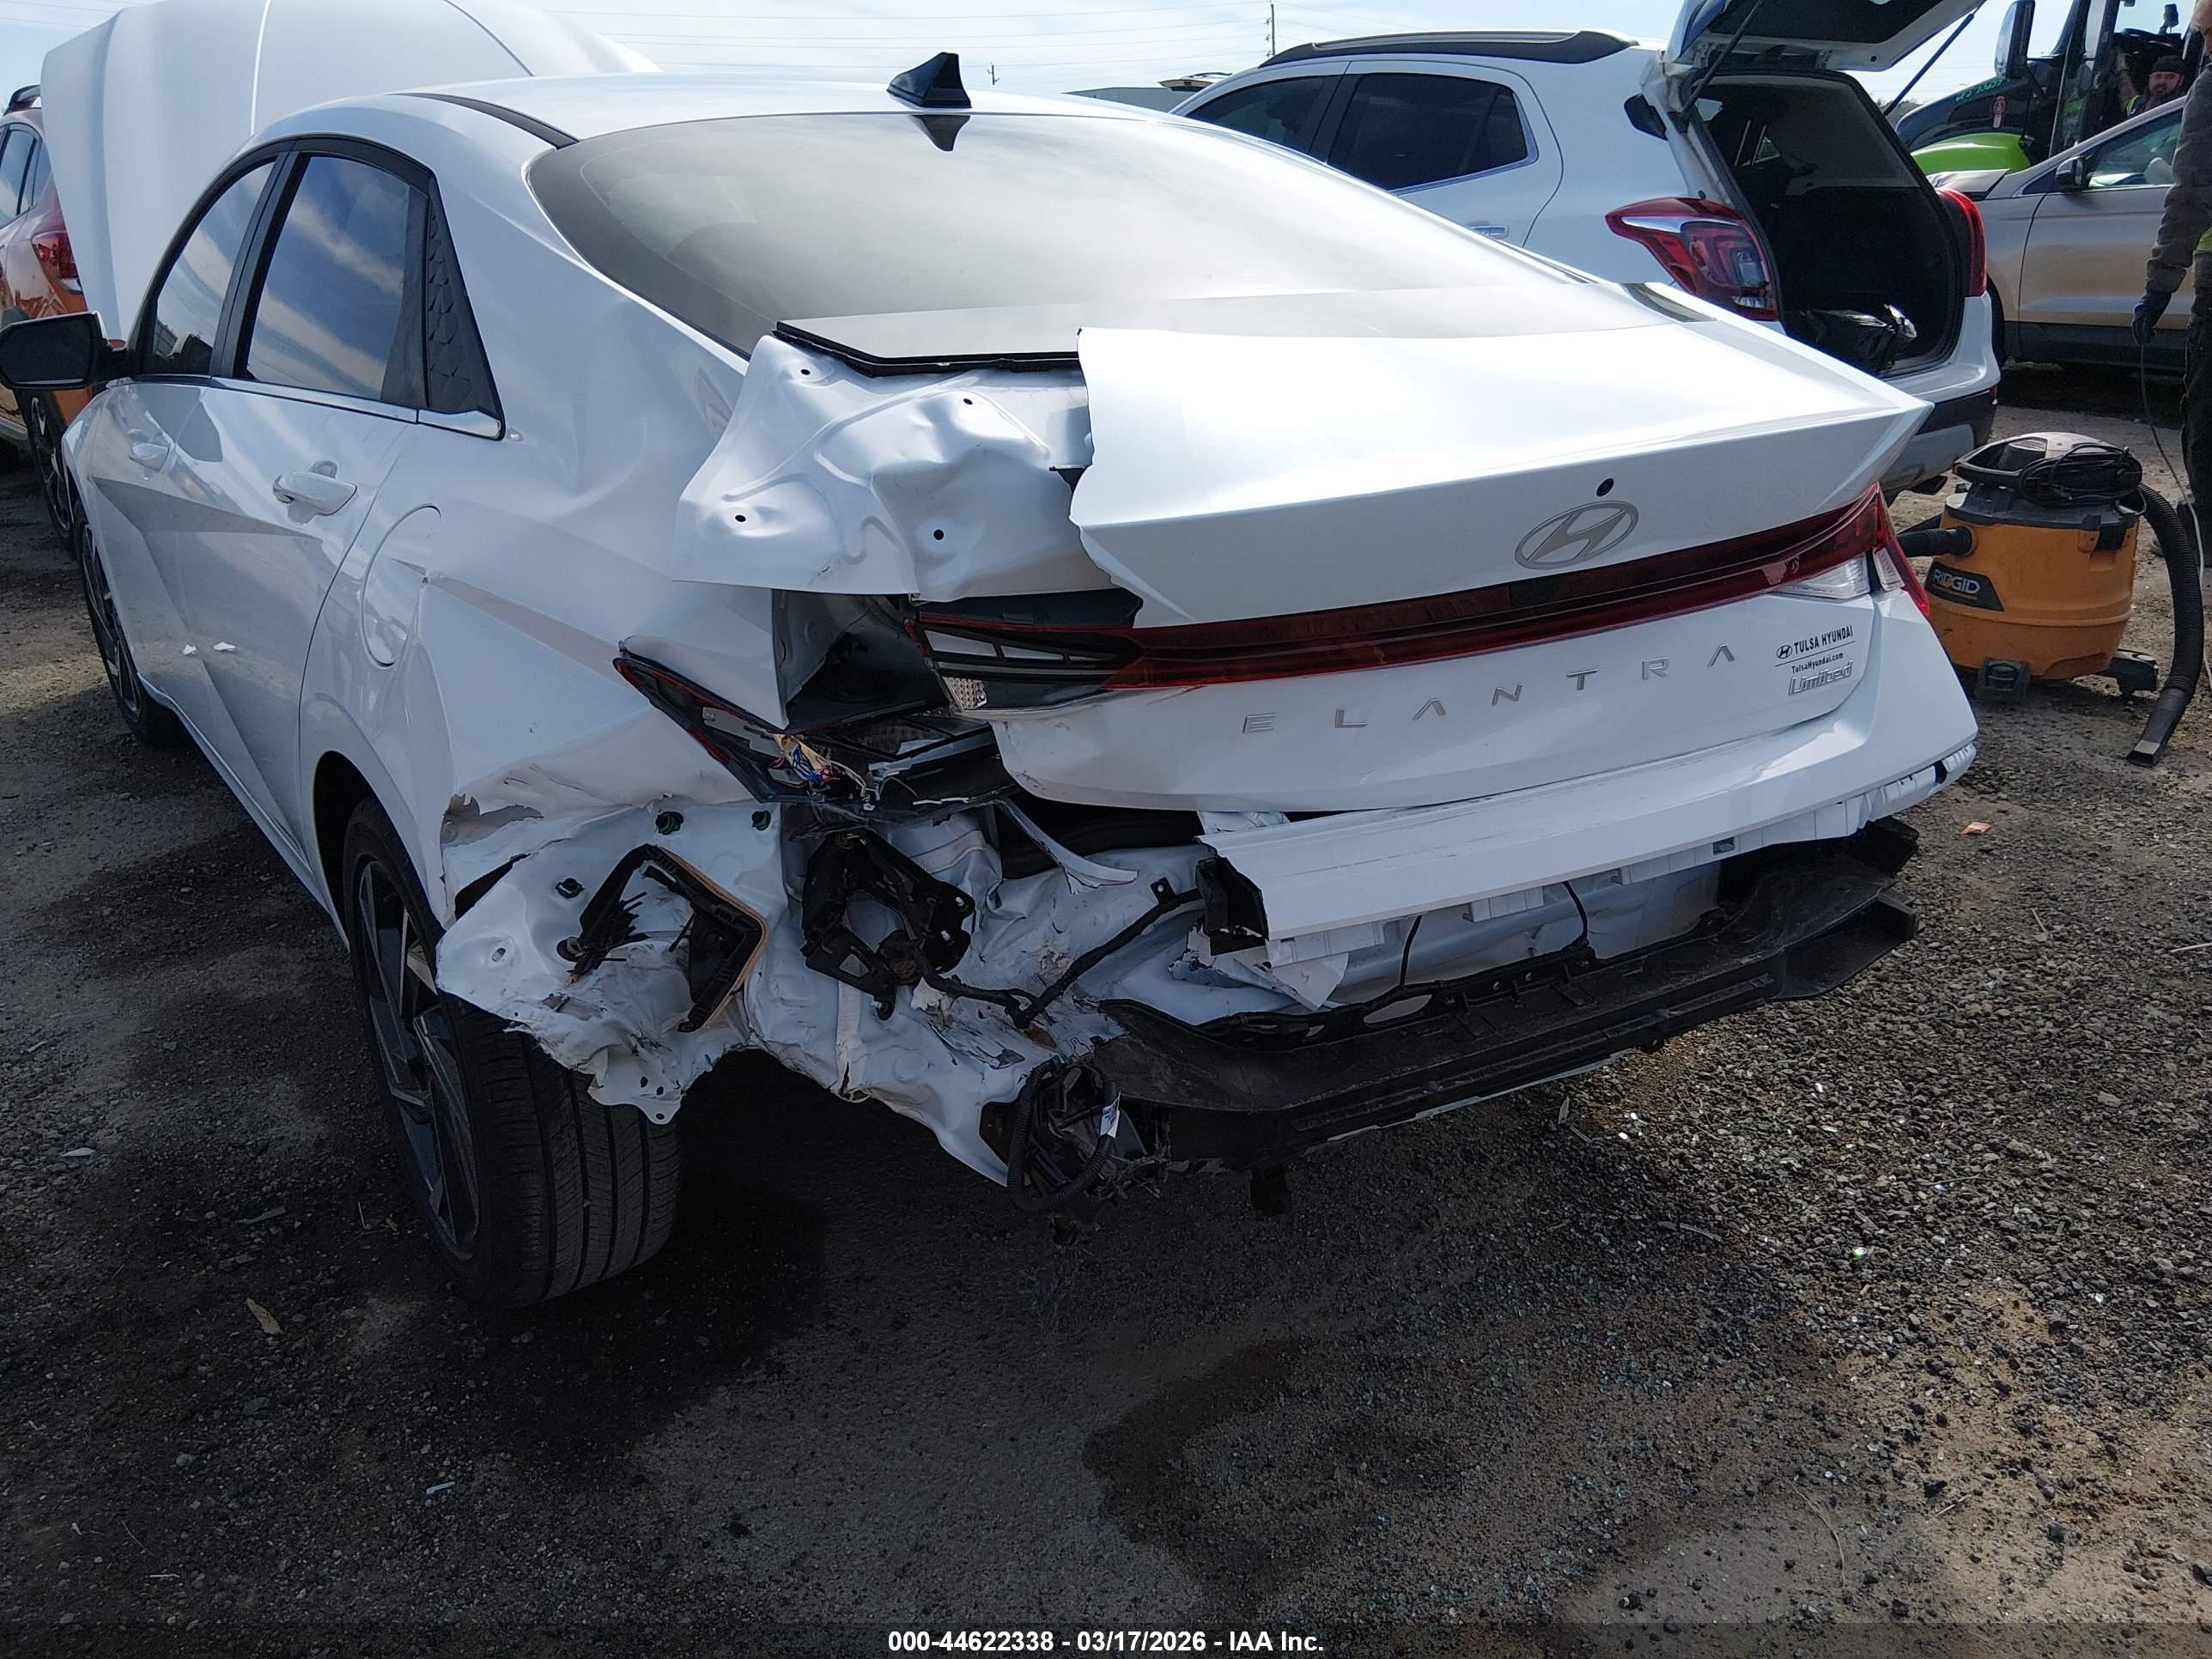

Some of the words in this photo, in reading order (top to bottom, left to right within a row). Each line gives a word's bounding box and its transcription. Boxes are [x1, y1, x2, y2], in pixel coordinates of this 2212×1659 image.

[1933, 569, 1980, 594] RIDGID
[1794, 636, 1820, 654] TULSA
[1821, 625, 1854, 646] HYUNDAI
[1789, 659, 1853, 696] Limited
[1791, 653, 1844, 673] TulsaHyundai.com
[1242, 642, 1735, 734] ELANTRA
